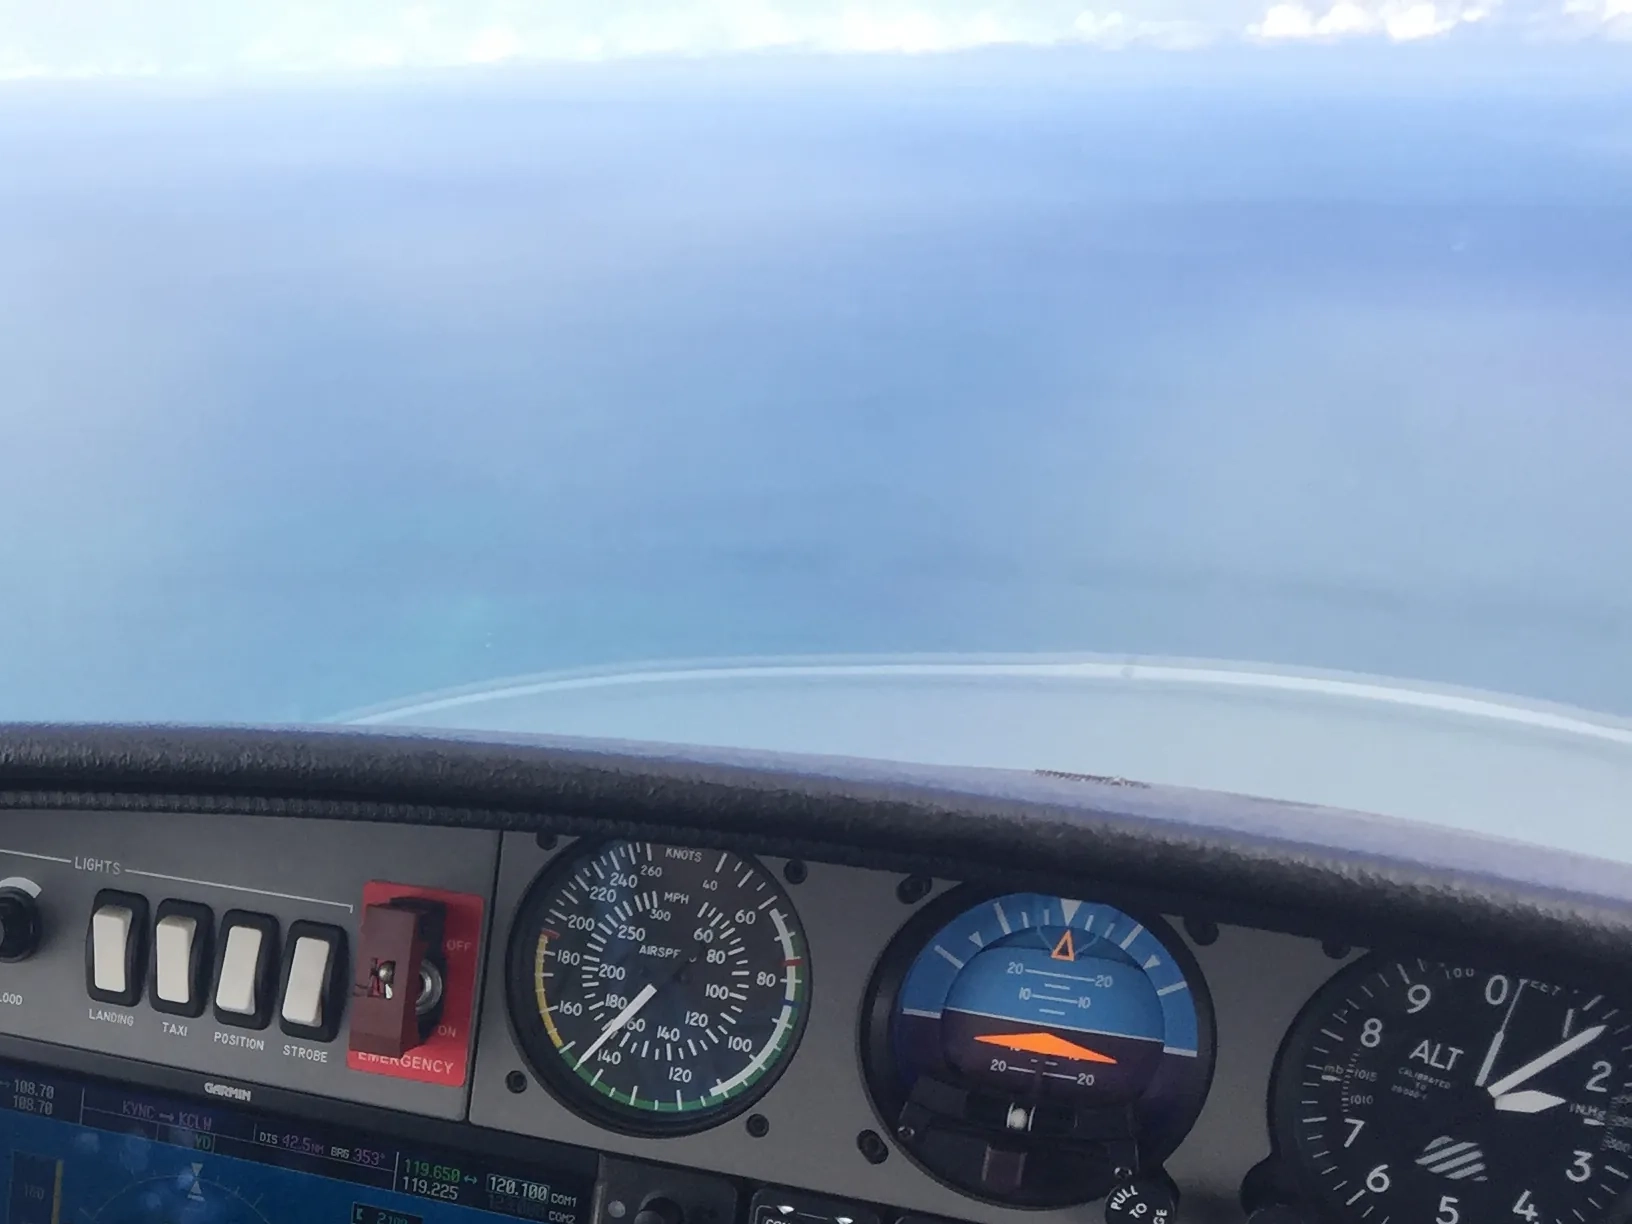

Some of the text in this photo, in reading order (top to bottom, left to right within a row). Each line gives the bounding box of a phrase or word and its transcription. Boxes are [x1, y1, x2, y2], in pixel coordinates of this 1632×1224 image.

[665, 847, 703, 863] KNOTS
[74, 857, 122, 876] LIGHTS
[609, 872, 638, 889] 240
[589, 884, 616, 903] 220
[663, 891, 690, 905] MPH
[568, 914, 595, 932] 200
[734, 909, 756, 925] 60
[618, 924, 646, 942] 250
[446, 939, 471, 951] OFF
[599, 964, 626, 981] 200
[756, 971, 776, 987] 80
[1406, 984, 1432, 1015] 9
[1484, 973, 1508, 1007] 0
[88, 1008, 135, 1028] LANDING
[162, 1021, 189, 1038] TAXI
[1360, 1017, 1383, 1048] 8
[214, 1031, 265, 1051] POSITION
[283, 1044, 329, 1063] STROBE
[1408, 1039, 1465, 1072] ALT
[1585, 1061, 1612, 1094] 2
[13, 1078, 56, 1100] 108.70
[203, 1081, 252, 1102] GARMIN
[1344, 1117, 1366, 1148] 7
[403, 1157, 461, 1184] 119.650
[1565, 1150, 1594, 1183] 3
[402, 1176, 459, 1201] 119.225
[489, 1175, 549, 1202] 120.100
[1366, 1163, 1390, 1194] 6
[1110, 1184, 1139, 1211] PULL
[1512, 1189, 1538, 1222] 4
[1129, 1202, 1148, 1219] TO
